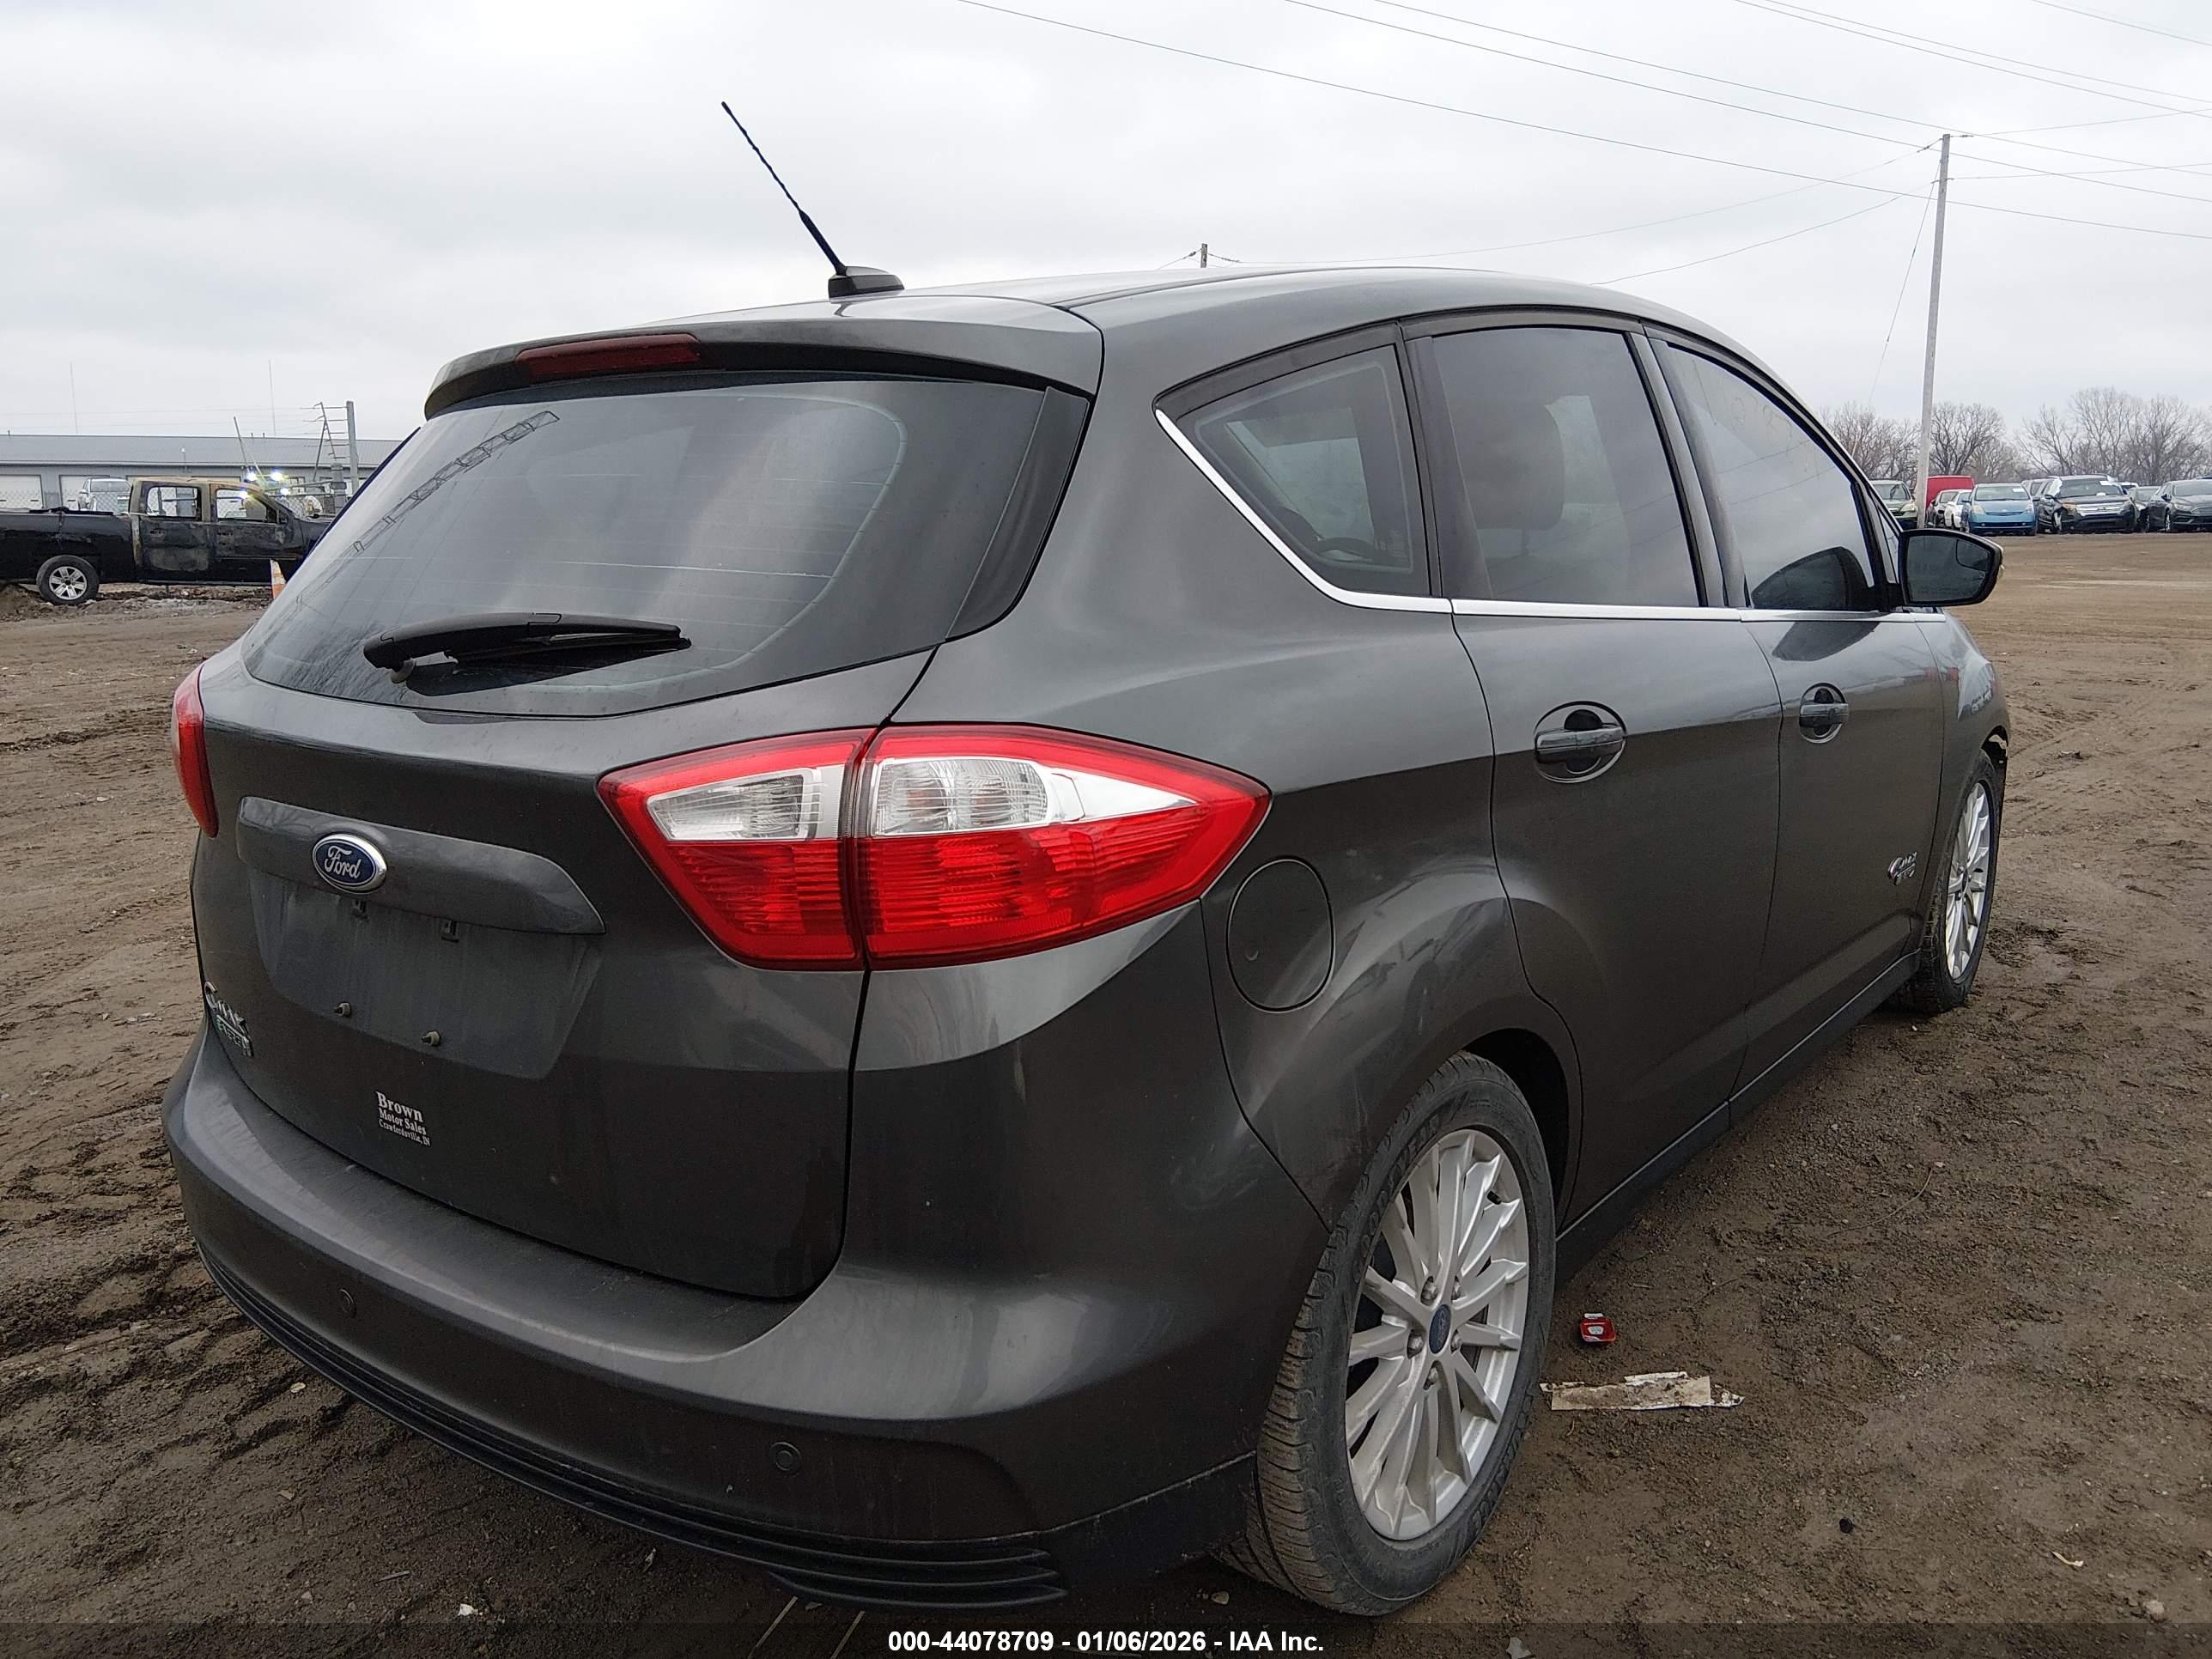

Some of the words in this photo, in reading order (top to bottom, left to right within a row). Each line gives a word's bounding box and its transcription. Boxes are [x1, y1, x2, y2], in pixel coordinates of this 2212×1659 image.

[324, 845, 362, 879] Ford
[375, 1091, 424, 1123] Brown
[378, 1107, 404, 1127] Motor
[404, 1117, 427, 1135] Sales
